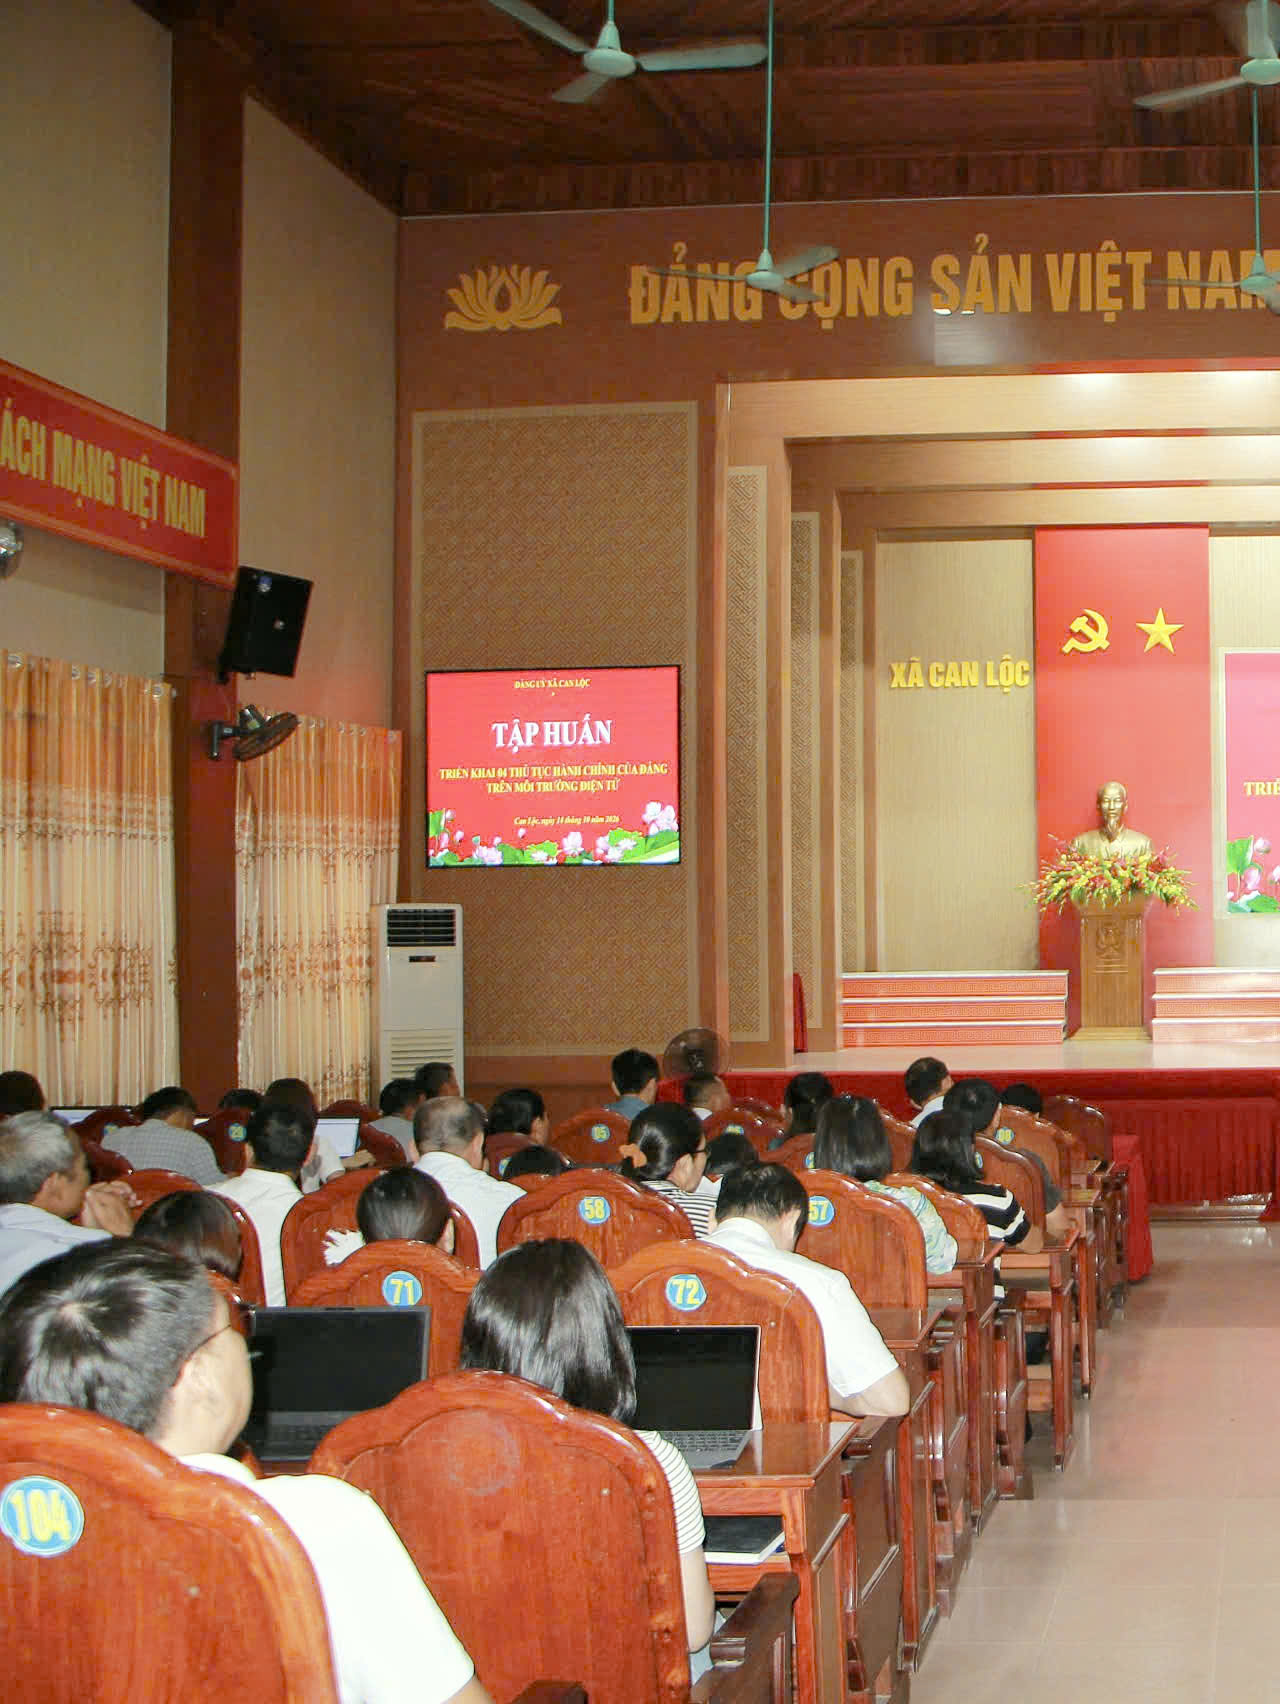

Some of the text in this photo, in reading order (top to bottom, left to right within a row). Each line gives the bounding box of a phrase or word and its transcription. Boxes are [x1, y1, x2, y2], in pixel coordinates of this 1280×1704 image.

[629, 242, 763, 324] ĐẢNG
[930, 232, 1032, 315] SẢN
[1045, 239, 1152, 322] VIỆT
[52, 430, 115, 508] MẠNG
[120, 455, 161, 529] VIỆT
[165, 475, 206, 538] NAM
[890, 653, 1030, 693] XÃ CAN LỘC
[492, 713, 612, 753] TẬP HUẤN
[584, 1197, 604, 1218] 58
[808, 1202, 828, 1221] 57
[391, 1279, 414, 1305] 71
[674, 1279, 700, 1304] 72
[8, 1489, 70, 1541] 104
